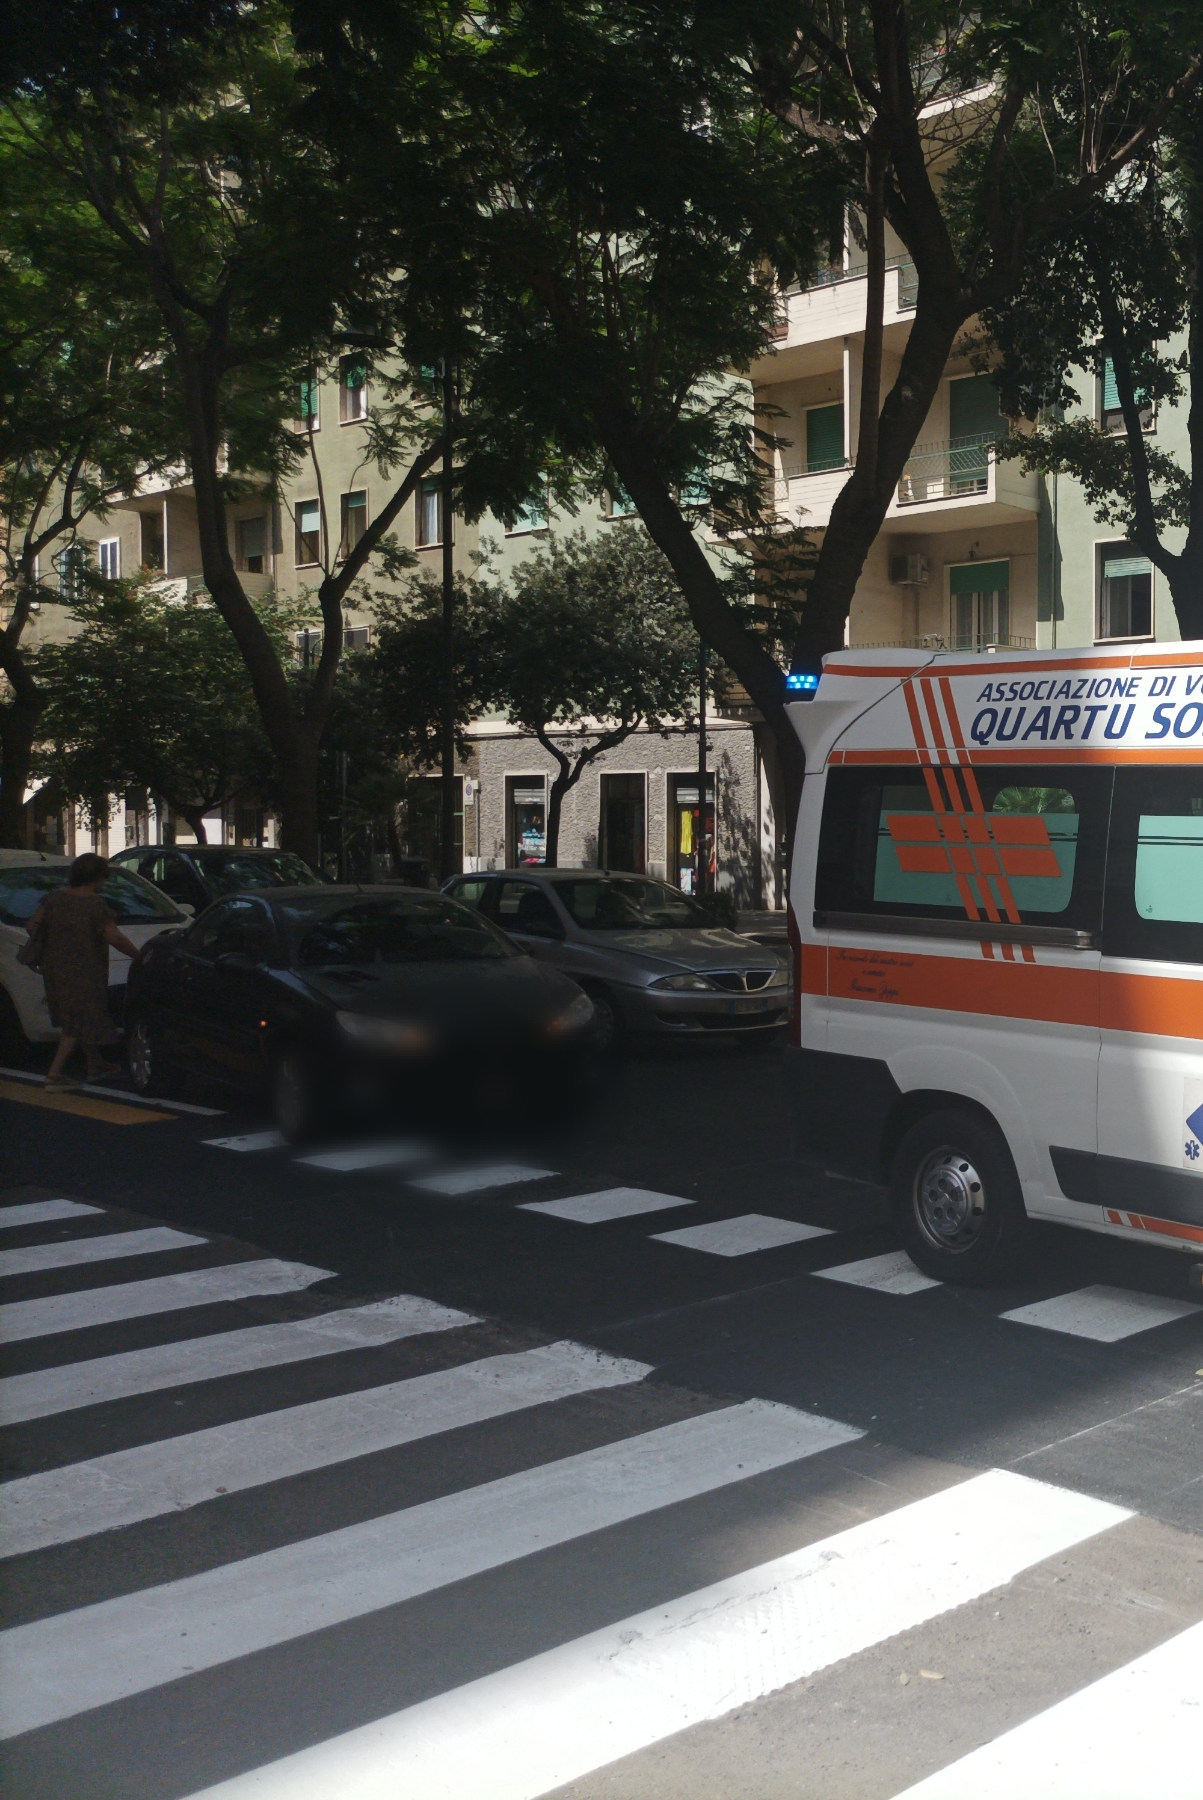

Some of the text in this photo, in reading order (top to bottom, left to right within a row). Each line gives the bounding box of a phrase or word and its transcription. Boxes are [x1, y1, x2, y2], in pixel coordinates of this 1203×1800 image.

[977, 676, 1143, 703] ASSOCIAZIONE
[1149, 675, 1177, 697] DI
[970, 703, 1135, 746] QUARTU
